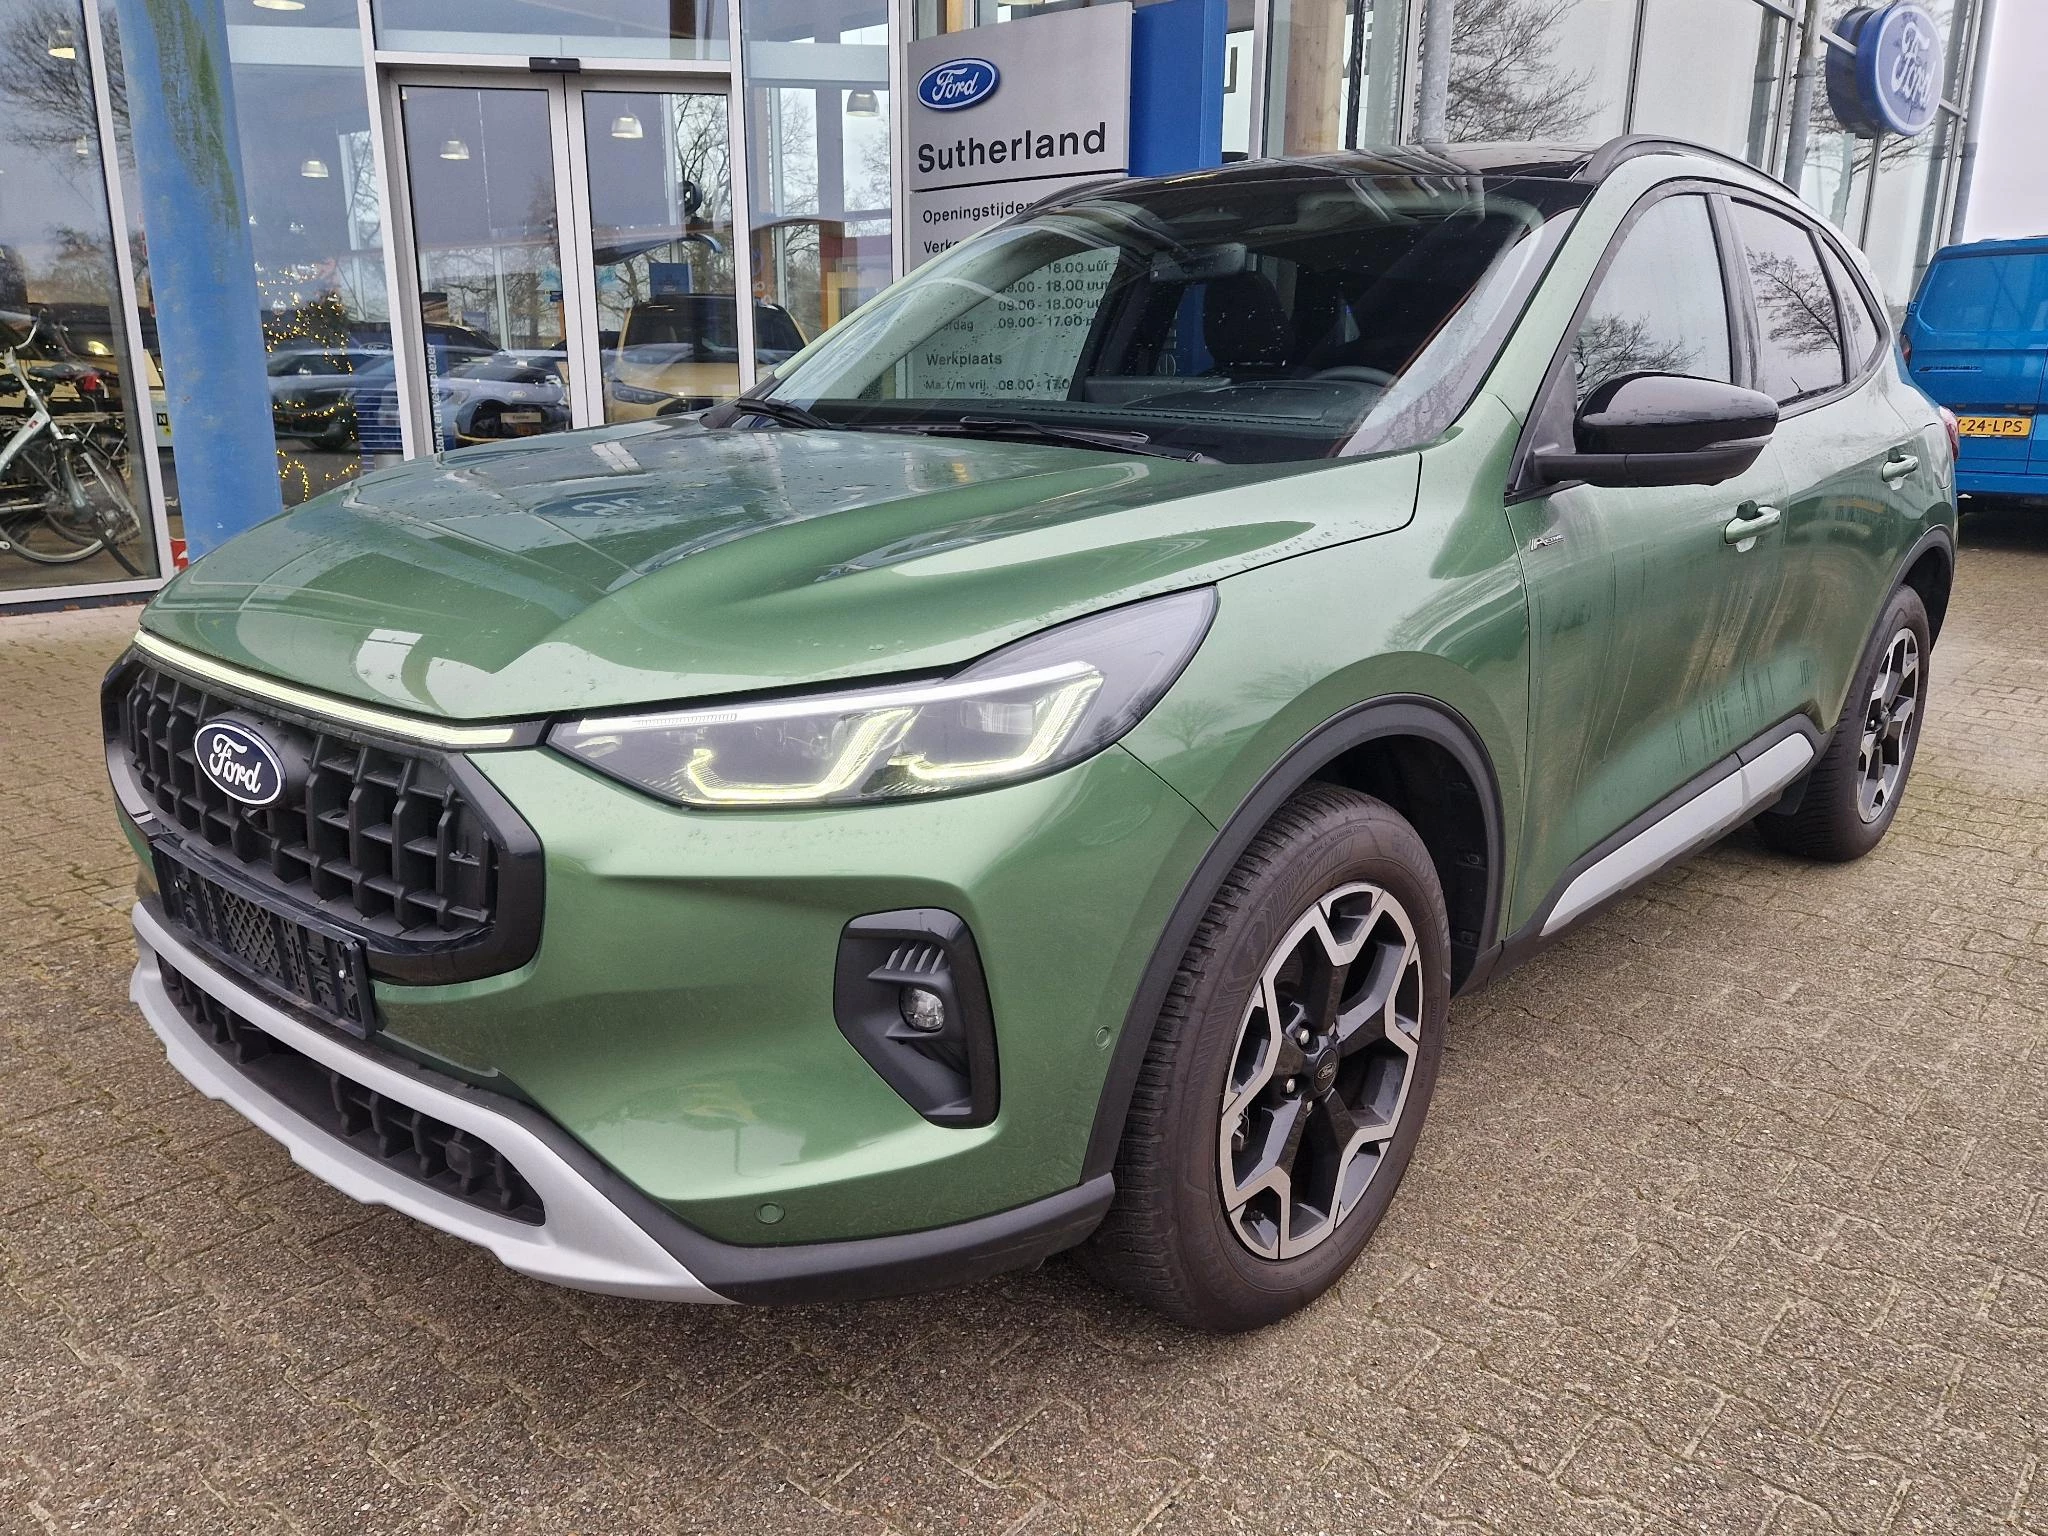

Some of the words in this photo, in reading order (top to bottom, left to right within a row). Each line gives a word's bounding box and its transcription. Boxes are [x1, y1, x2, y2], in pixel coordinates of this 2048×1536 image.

[918, 121, 1106, 173] Sutherland
[1048, 262, 1084, 274] 18.00
[1001, 281, 1034, 293] 9.00
[1046, 280, 1084, 292] 18.00
[998, 300, 1035, 311] 09.00
[1047, 298, 1083, 310] 18.00
[998, 316, 1035, 328] 09.00
[1047, 316, 1082, 327] 17.00
[926, 353, 1003, 367] Werkplaats
[998, 380, 1034, 391] 08.00
[433, 410, 442, 424] en
[209, 733, 262, 794] Ford
